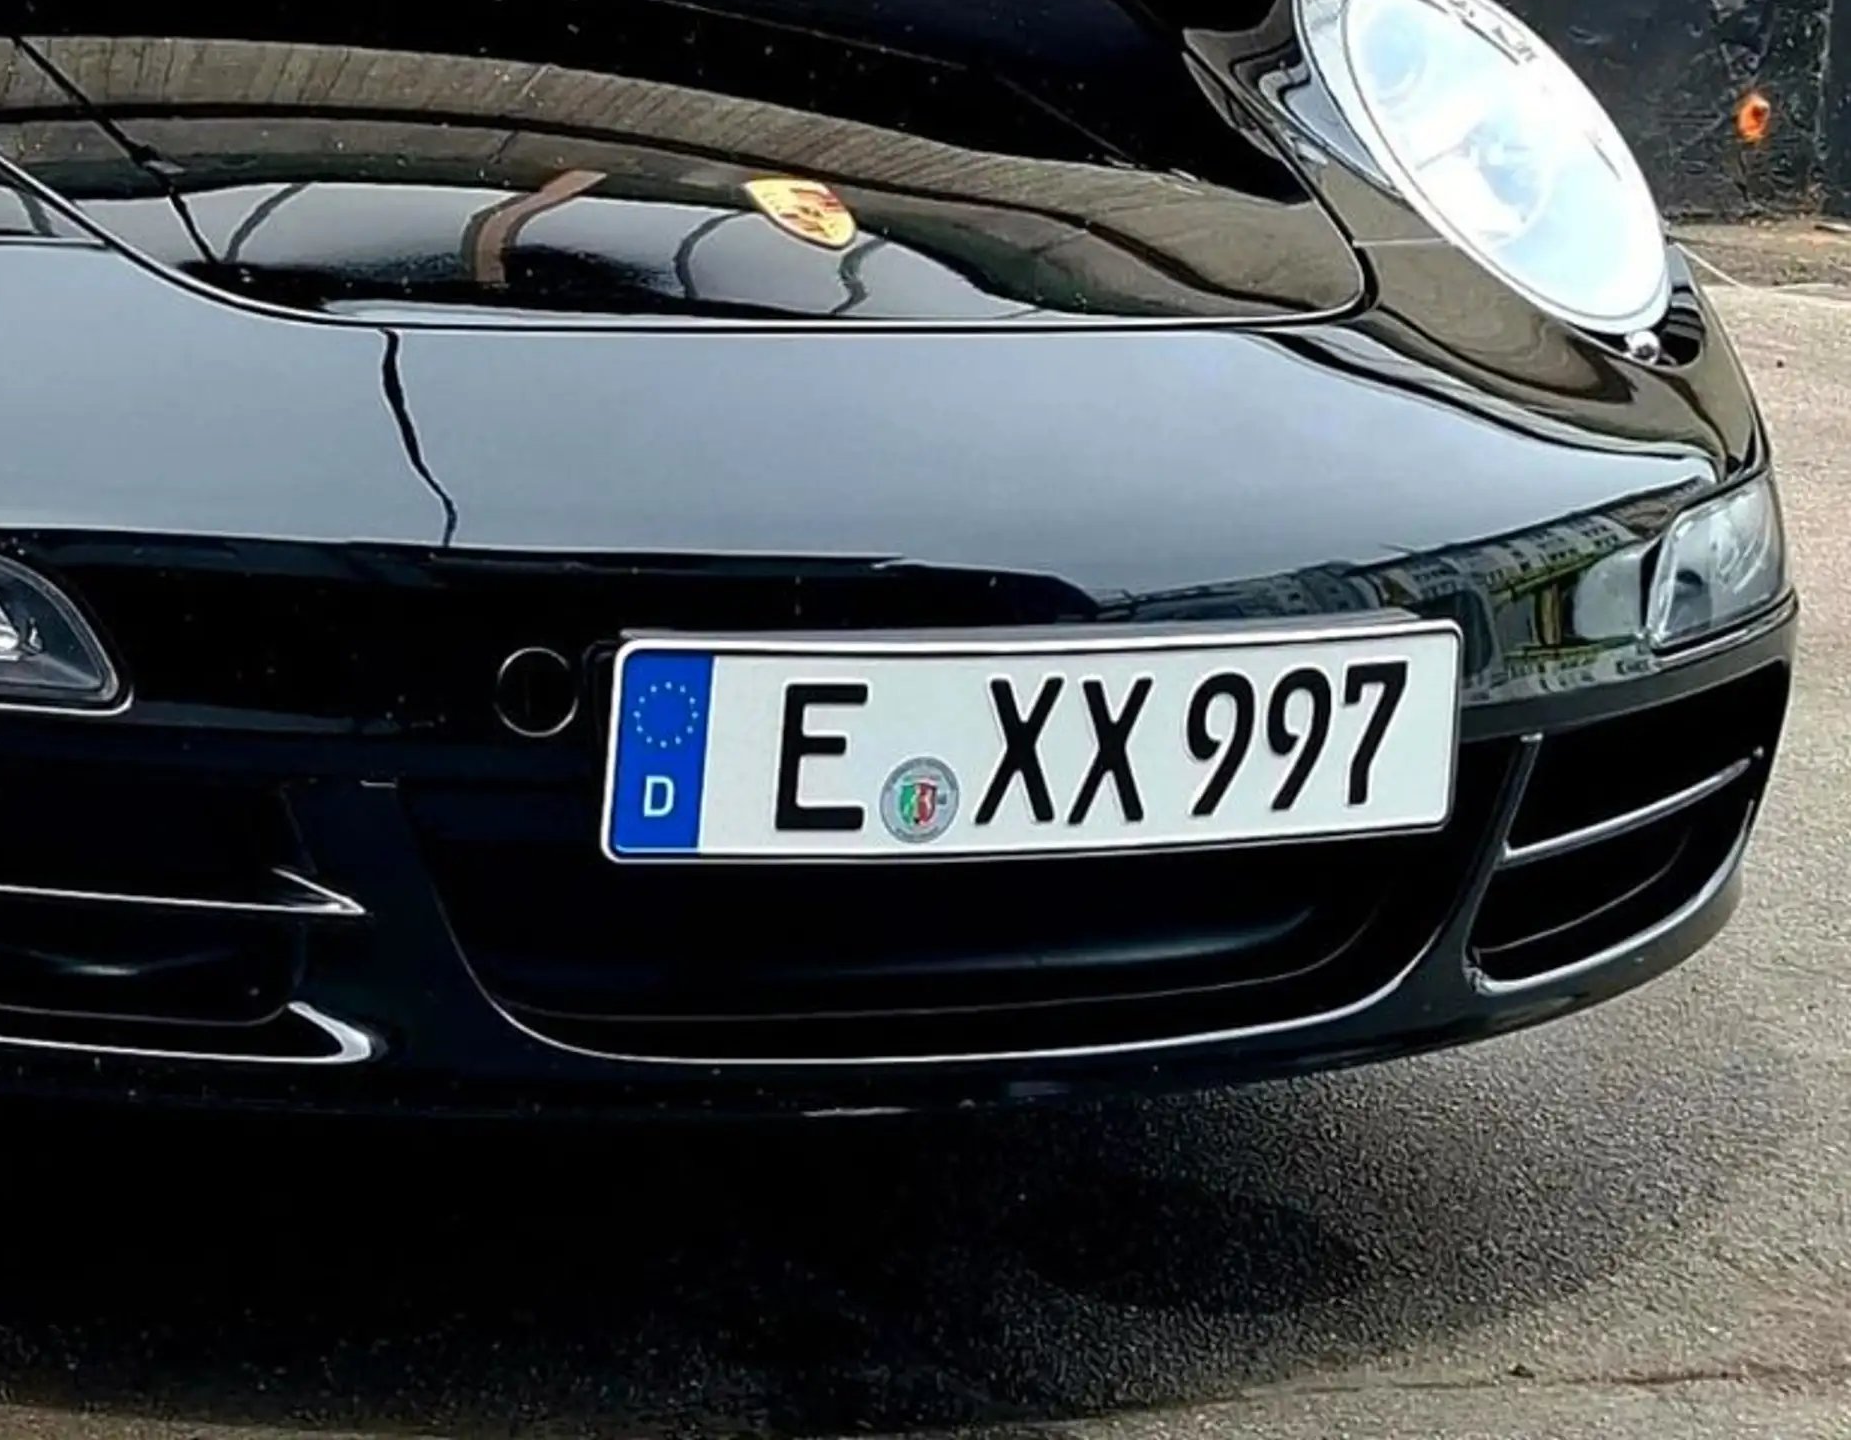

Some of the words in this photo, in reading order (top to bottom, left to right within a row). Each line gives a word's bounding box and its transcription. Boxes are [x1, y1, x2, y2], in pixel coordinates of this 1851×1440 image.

[642, 775, 676, 819] D
[773, 682, 869, 833] E
[973, 675, 1153, 826] XX
[1185, 660, 1410, 818] 997
